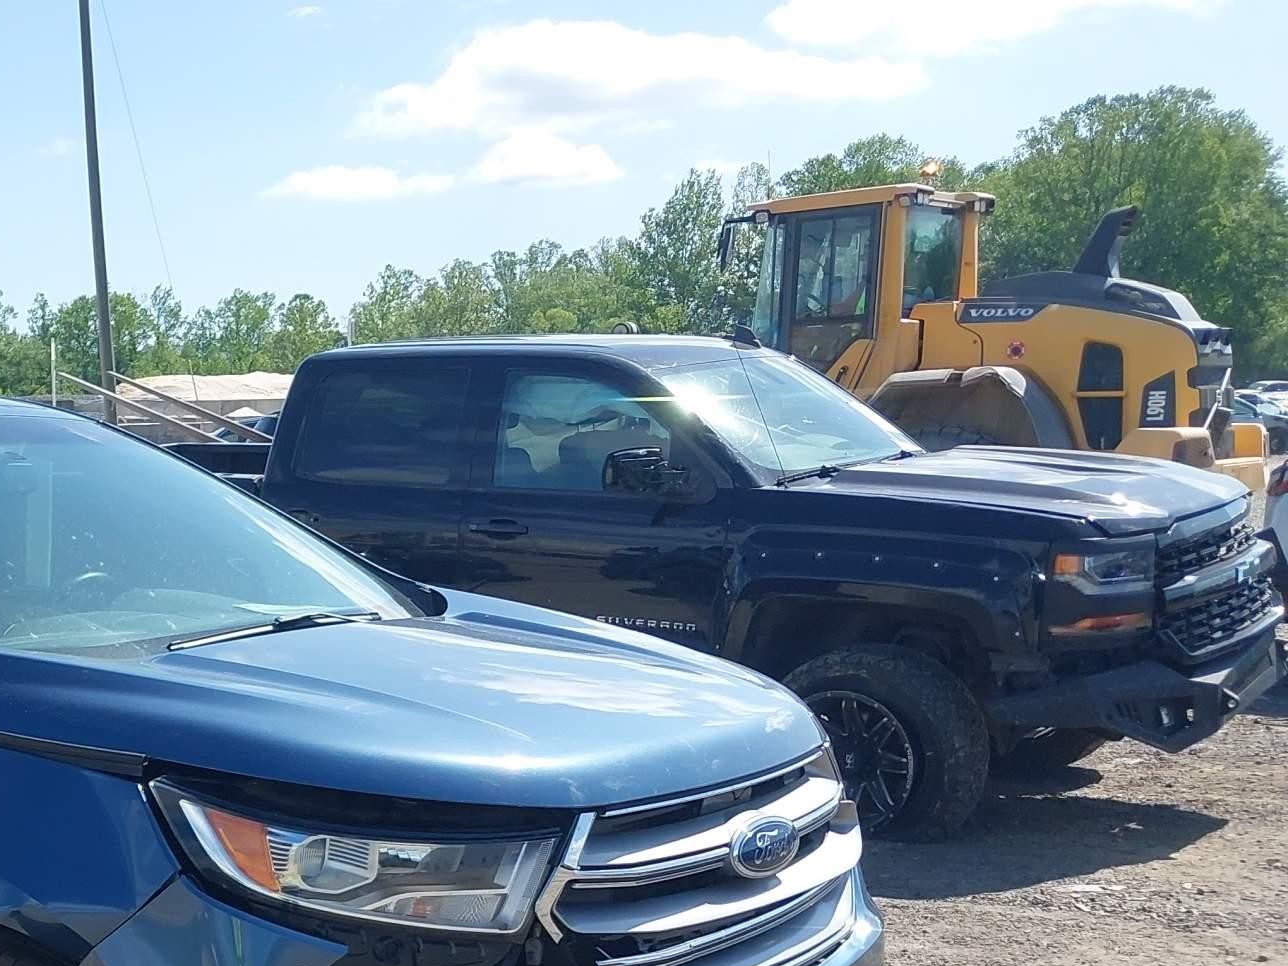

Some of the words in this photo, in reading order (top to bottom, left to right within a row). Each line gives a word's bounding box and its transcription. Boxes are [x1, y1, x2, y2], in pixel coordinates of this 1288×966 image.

[968, 307, 1034, 318] VOLVO
[1146, 390, 1167, 422] L90H
[754, 828, 789, 865] Ford
